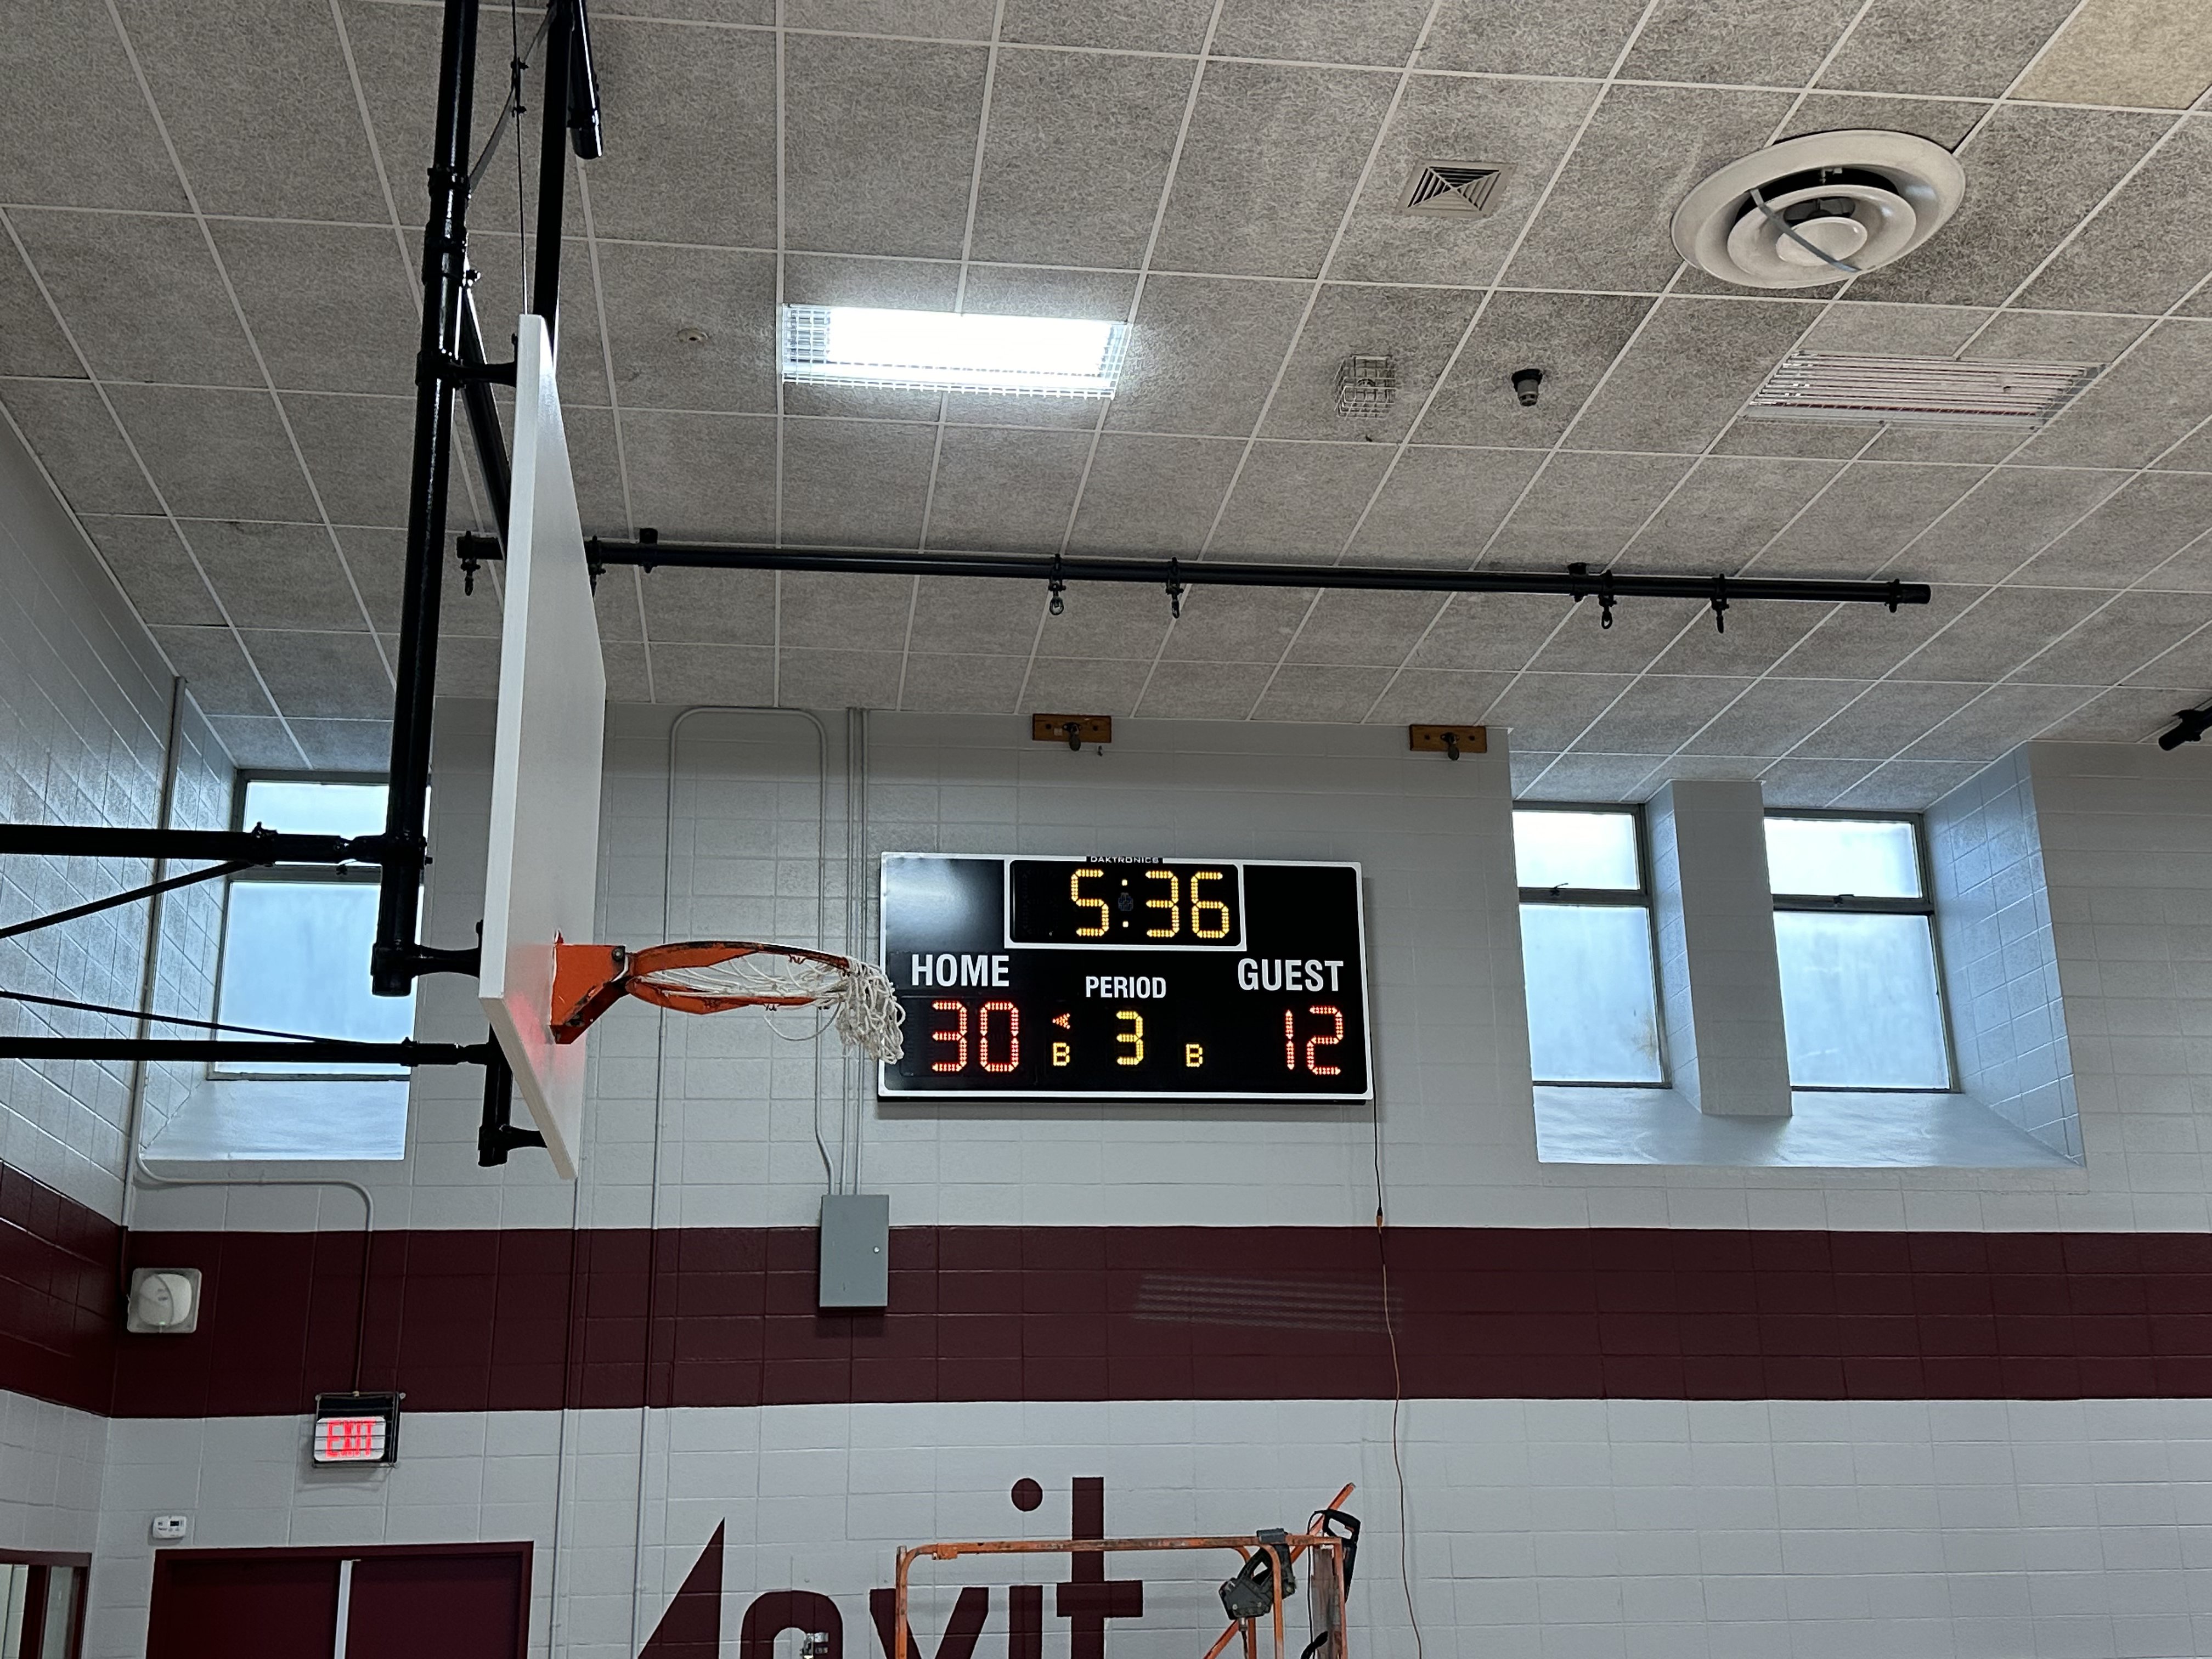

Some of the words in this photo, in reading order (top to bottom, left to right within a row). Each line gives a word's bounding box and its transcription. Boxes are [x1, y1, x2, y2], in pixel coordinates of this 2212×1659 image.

[1071, 869, 1229, 938] 5:36
[912, 954, 1009, 986] HOME
[1086, 977, 1166, 998] PERIOD
[1238, 958, 1344, 991] GUEST
[932, 1001, 1019, 1072] 30
[1053, 1042, 1070, 1066] B
[1116, 1011, 1143, 1065] 3
[1285, 1006, 1343, 1075] 12
[1186, 1044, 1203, 1067] B
[326, 1420, 375, 1458] EXIT
